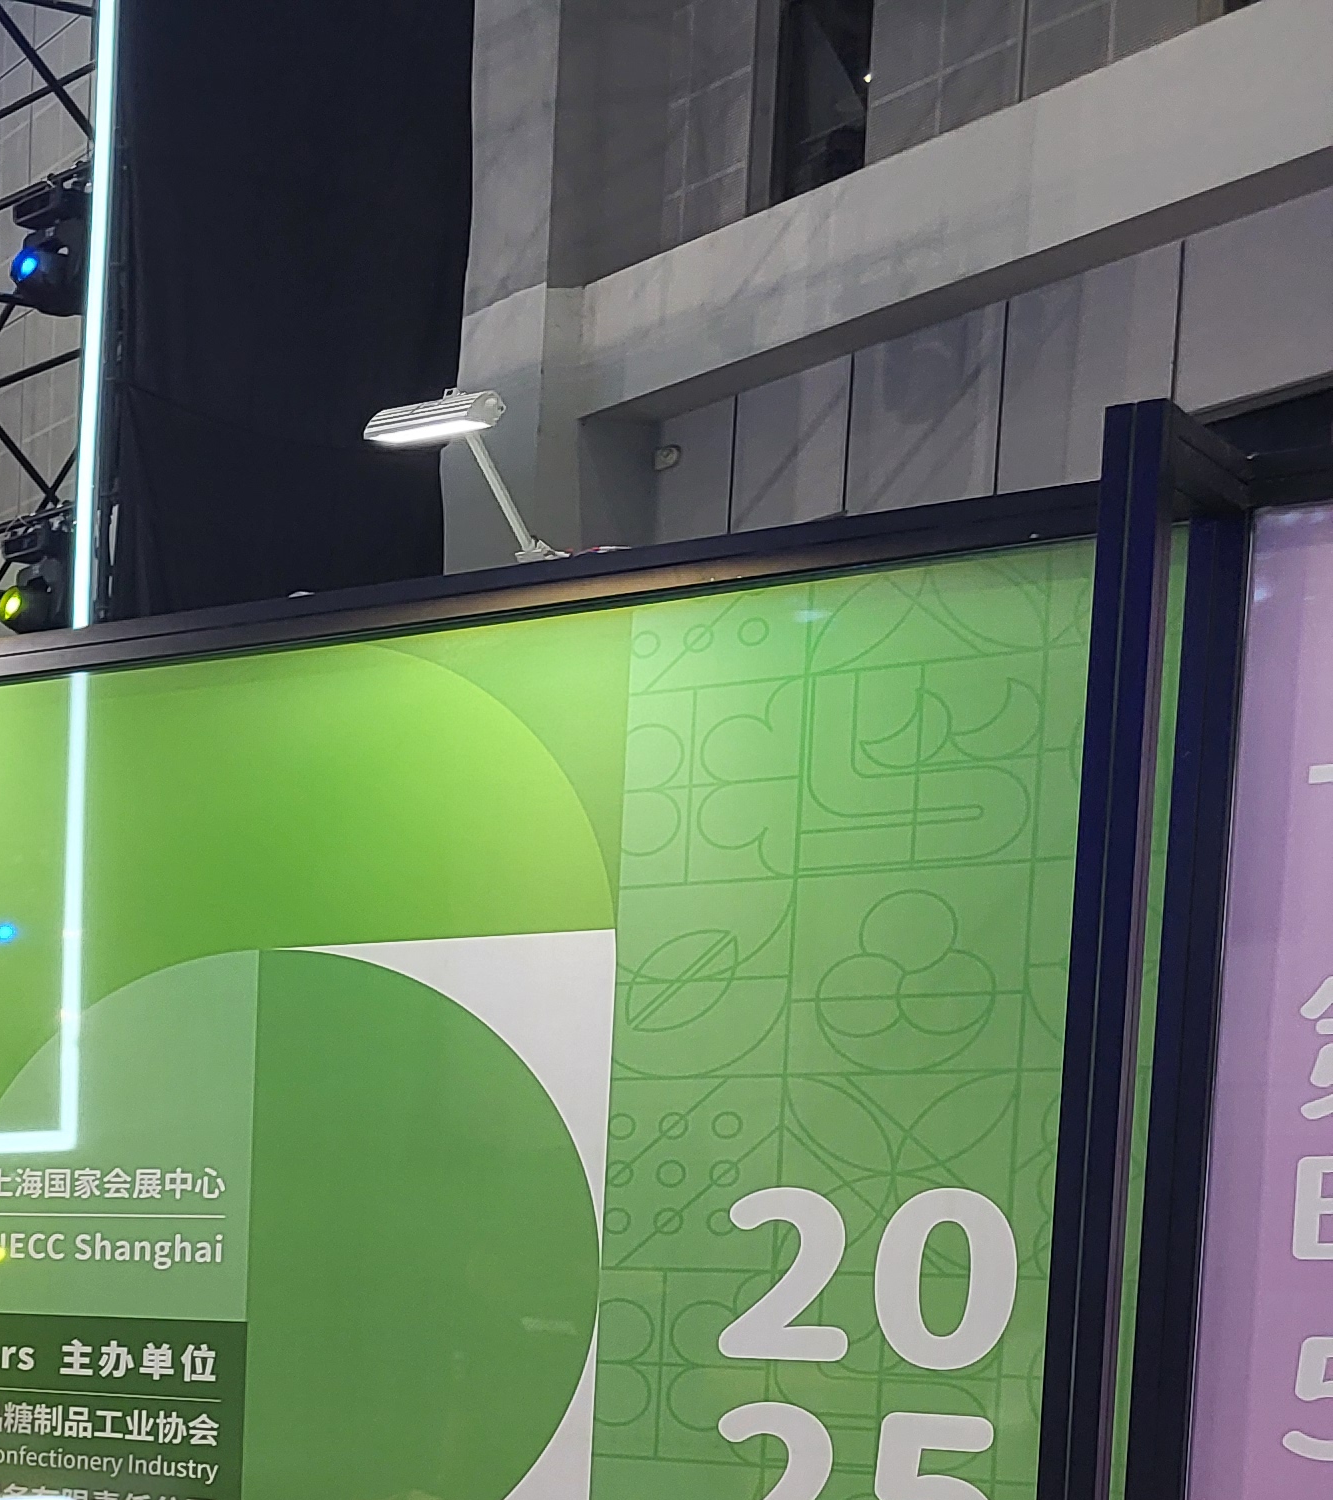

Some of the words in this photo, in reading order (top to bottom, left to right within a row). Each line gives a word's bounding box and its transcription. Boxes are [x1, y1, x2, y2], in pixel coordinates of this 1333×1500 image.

[74, 1232, 224, 1270] Shanghai
[718, 1186, 1018, 1371] 20
[59, 1338, 217, 1383] 主办单位
[128, 1453, 219, 1485] Industry
